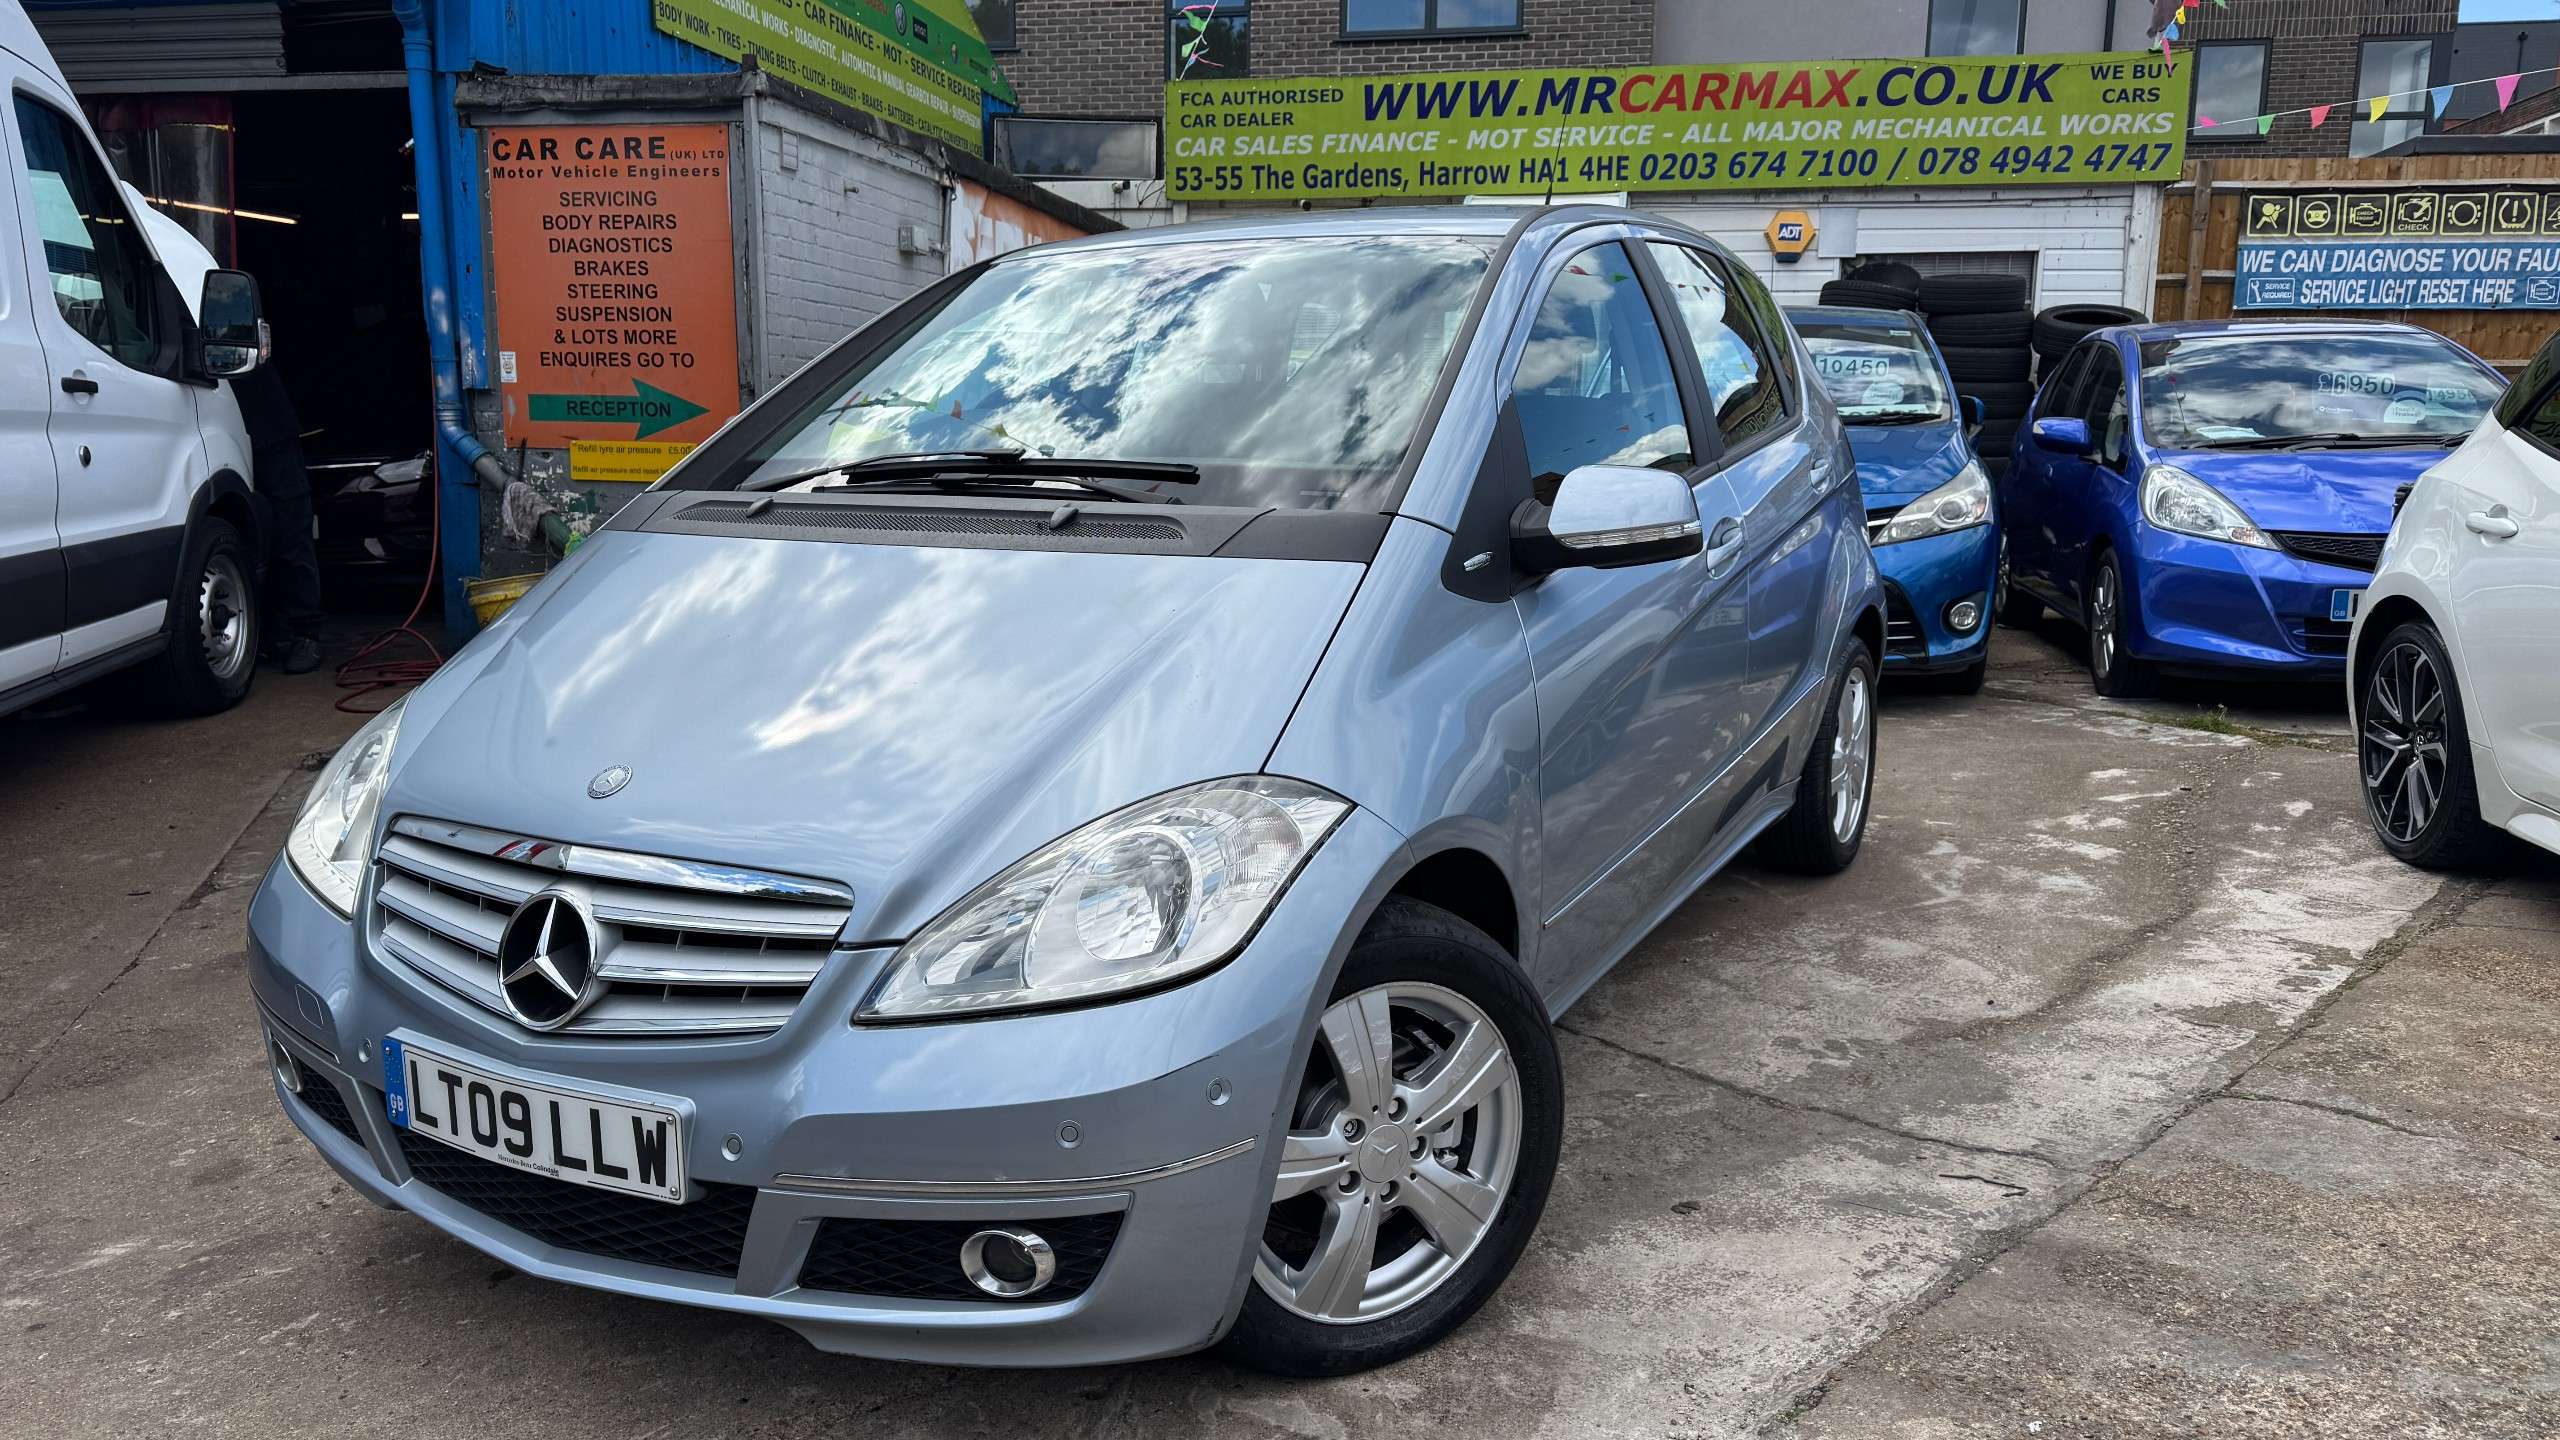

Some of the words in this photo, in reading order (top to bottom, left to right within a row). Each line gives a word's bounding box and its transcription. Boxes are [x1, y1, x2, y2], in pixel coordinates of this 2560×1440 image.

[762, 11, 789, 38] WORKS
[795, 26, 837, 61] DIAGNOSTIC
[841, 50, 877, 80] AUTOMATIC
[882, 70, 905, 95] MANUAL
[804, 1, 826, 26] CAR
[830, 12, 874, 50] FINANCE
[883, 42, 902, 65] MOT
[911, 57, 945, 88] SERVICE
[948, 77, 981, 107] REPAIRS
[659, 1, 683, 24] BODY
[684, 13, 710, 37] WORK
[717, 27, 741, 50] TYRES
[748, 40, 775, 65] TIMING
[776, 53, 797, 75] BELTS
[802, 65, 826, 88] CLUTCH
[831, 78, 857, 100] EXHAUST
[862, 92, 883, 113] BRAKES
[887, 103, 914, 127] BATTERIES
[2090, 64, 2127, 81] WE
[2131, 63, 2178, 80] BUY
[1181, 91, 1217, 107] FCA
[1220, 88, 1344, 107] AUTHORISED
[1363, 63, 2064, 121] WWW.MRCARMAX.CO.UK
[2102, 87, 2161, 104] CARS
[1180, 113, 1217, 129] CAR
[1223, 111, 1294, 128] DEALER
[1175, 137, 1229, 158] CAR
[1233, 135, 1313, 156] SALES
[1322, 131, 1439, 154] FINANCE
[1466, 128, 1522, 150] MOT
[1533, 124, 1654, 148] SERVICE
[1681, 122, 1732, 143] ALL
[1742, 119, 1842, 142] MAJOR
[1850, 115, 2047, 140] MECHANICAL
[2059, 112, 2175, 136] WORKS
[492, 138, 559, 161] CAR
[575, 136, 666, 160] CARE
[670, 150, 697, 161] (UK)
[702, 150, 725, 159] LTD
[493, 165, 543, 179] Motor
[551, 165, 619, 179] Vehicle
[627, 164, 720, 181] Engineers
[1175, 166, 1243, 191] 53-55
[1250, 163, 1295, 190] The
[1303, 160, 1408, 193] Gardens,
[1419, 160, 1510, 186] Harrow
[1519, 157, 1568, 184] HA1
[1579, 155, 1629, 182] 4HE
[1639, 151, 1717, 181] 0203
[1728, 150, 1788, 179] 674
[1798, 148, 1878, 178] 7100
[1918, 146, 1981, 175] 078
[1990, 144, 2074, 174] 4942
[2084, 143, 2172, 173] 4747
[559, 191, 657, 207] SERVICING
[543, 215, 592, 231] BODY
[599, 214, 677, 230] REPAIRS
[2398, 223, 2429, 232] CHECK
[1778, 225, 1802, 240] ADT
[549, 237, 673, 253] DIAGNOSTICS
[574, 260, 649, 276] BRAKES
[2242, 250, 2275, 273] WE
[2280, 249, 2325, 273] CAN
[2331, 248, 2446, 273] DIAGNOSE
[2451, 248, 2514, 273] YOUR
[2515, 248, 2560, 272] FAU
[567, 283, 658, 300] STEERING
[2300, 280, 2365, 305] SERVICE
[2369, 279, 2417, 304] LIGHT
[2416, 279, 2475, 304] RESET
[2472, 279, 2516, 304] HERE
[556, 306, 672, 322] SUSPENSION
[554, 330, 566, 344] &
[571, 329, 618, 345] LOTS
[624, 330, 677, 345] MORE
[540, 352, 631, 368] ENQUIRES
[637, 352, 665, 368] GO
[669, 352, 695, 368] TO
[2318, 373, 2395, 395] £6950
[566, 400, 672, 418] RECEPTION
[390, 1094, 404, 1112] GB
[410, 1060, 534, 1158] LT09
[550, 1100, 667, 1187] LLW
